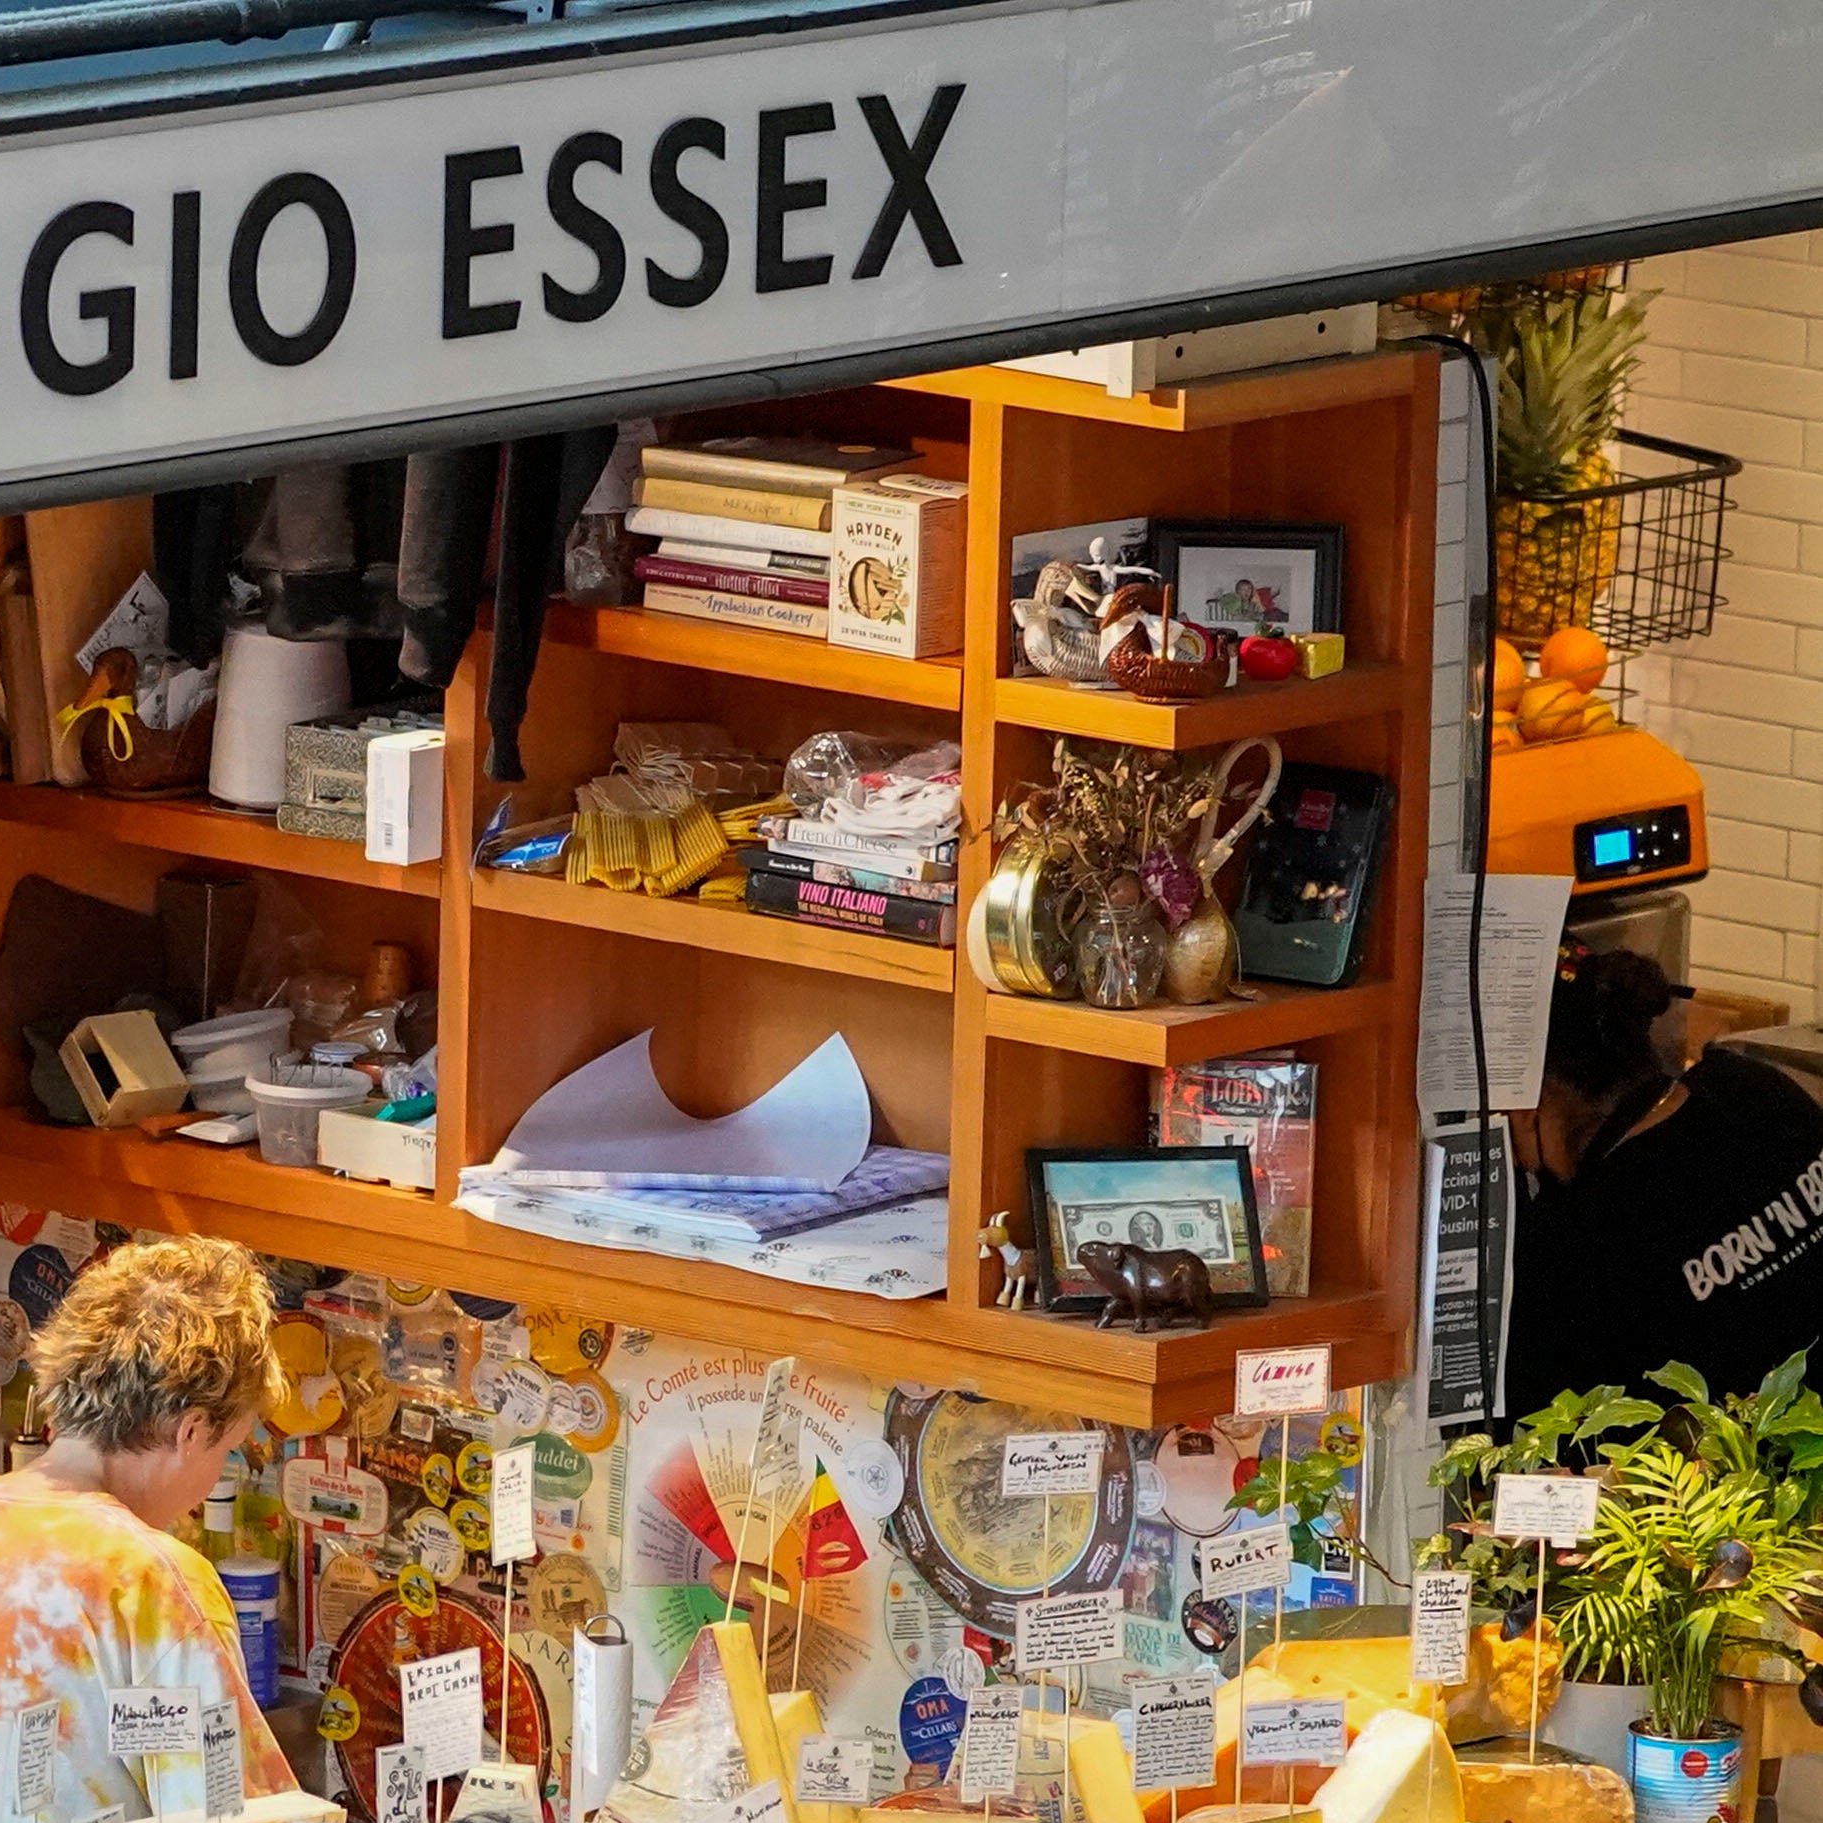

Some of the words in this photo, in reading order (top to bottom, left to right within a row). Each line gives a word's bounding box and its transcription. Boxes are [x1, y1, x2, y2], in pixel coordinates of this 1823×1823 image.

[443, 82, 968, 340] ESSEX
[845, 519, 905, 547] HAYDEN
[792, 825, 835, 850] French
[839, 831, 897, 856] Cheese
[797, 881, 828, 905] VINO
[830, 885, 888, 916] ITALIANO
[1449, 1146, 1503, 1165] reques
[1439, 1213, 1500, 1235] busines.
[1681, 1214, 1776, 1301] BORN
[1739, 1261, 1780, 1291] LOWER
[1782, 1241, 1808, 1265] EAST
[628, 1399, 650, 1424] Le
[645, 1358, 699, 1402] Comté
[703, 1359, 728, 1378] est
[732, 1349, 765, 1379] plus
[803, 1371, 847, 1424] fruité
[685, 1394, 697, 1413] il
[697, 1384, 747, 1411] possède
[803, 1414, 844, 1457] palette
[1210, 1544, 1279, 1574] RUPERT
[112, 1702, 188, 1724] MANCHEGO
[916, 1697, 949, 1719] OMA
